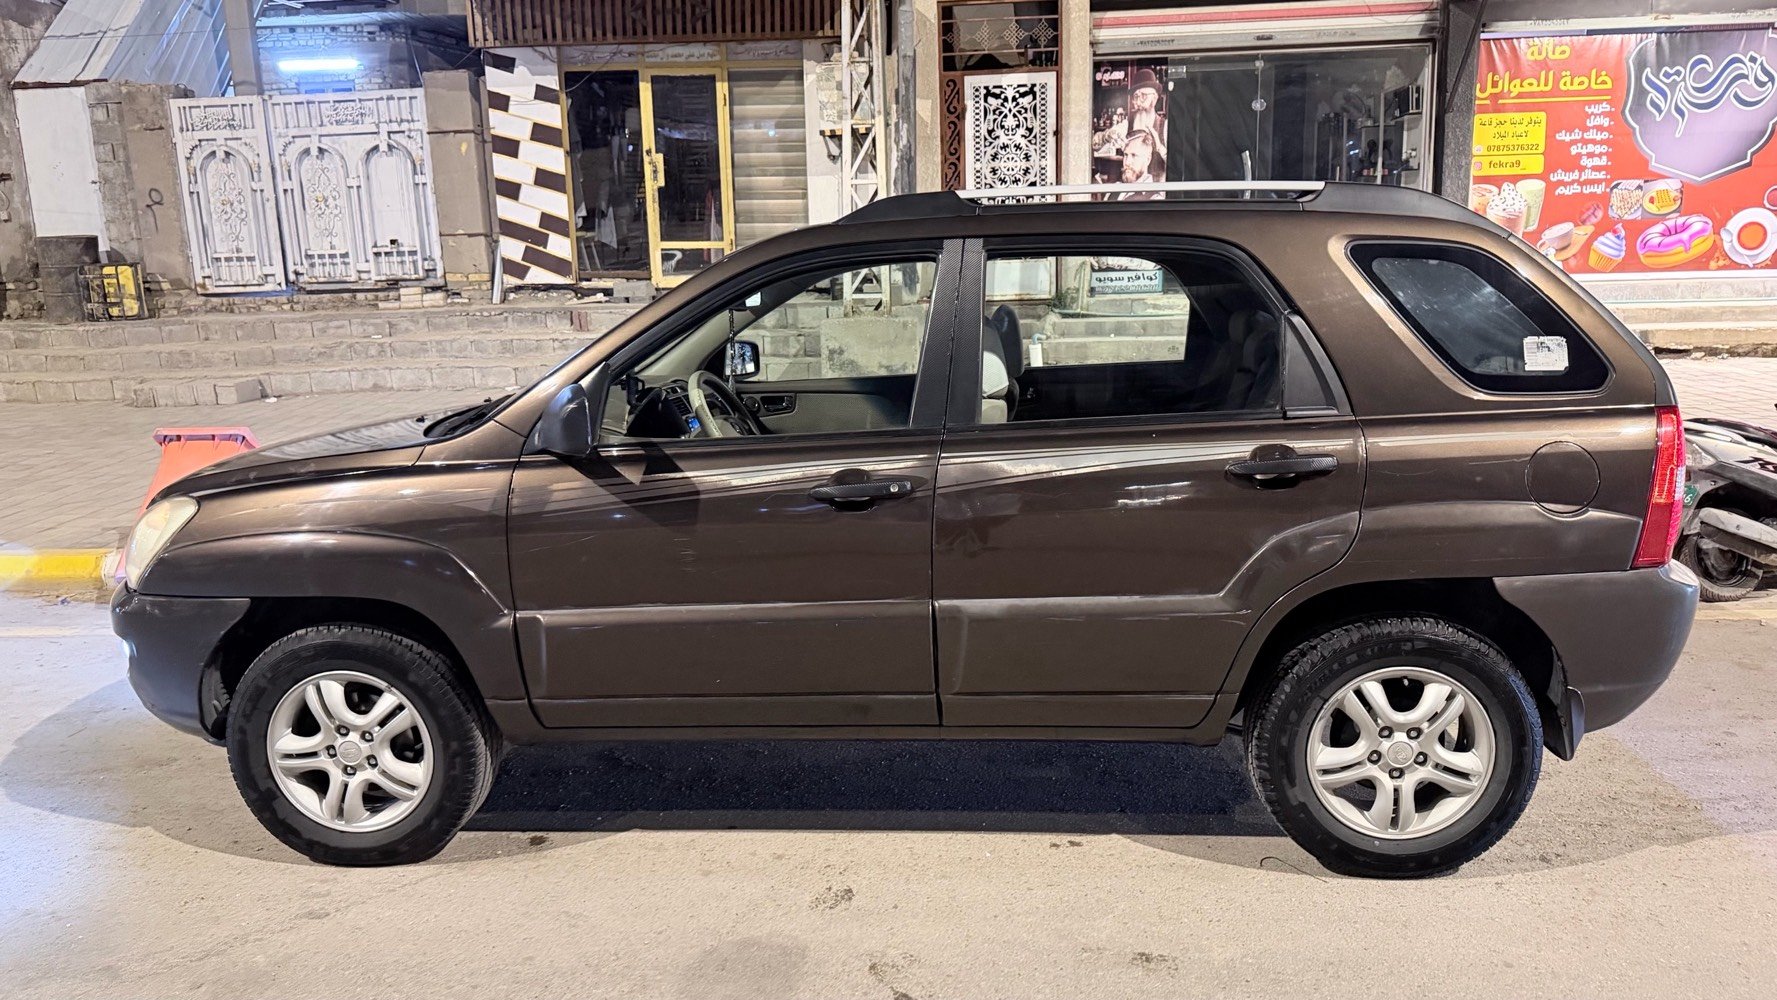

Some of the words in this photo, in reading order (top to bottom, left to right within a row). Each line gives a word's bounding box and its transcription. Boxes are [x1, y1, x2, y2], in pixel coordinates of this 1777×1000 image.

[1527, 38, 1571, 61] صالة
[1476, 70, 1554, 98] للعوائل
[1559, 68, 1613, 91] خاصة
[1479, 118, 1493, 126] قاعة
[1510, 117, 1524, 128] لدينا
[1555, 128, 1582, 142] شيك
[1486, 143, 1540, 153] 07875376322
[1549, 169, 1579, 182] فريش
[1555, 183, 1581, 195] كريم
